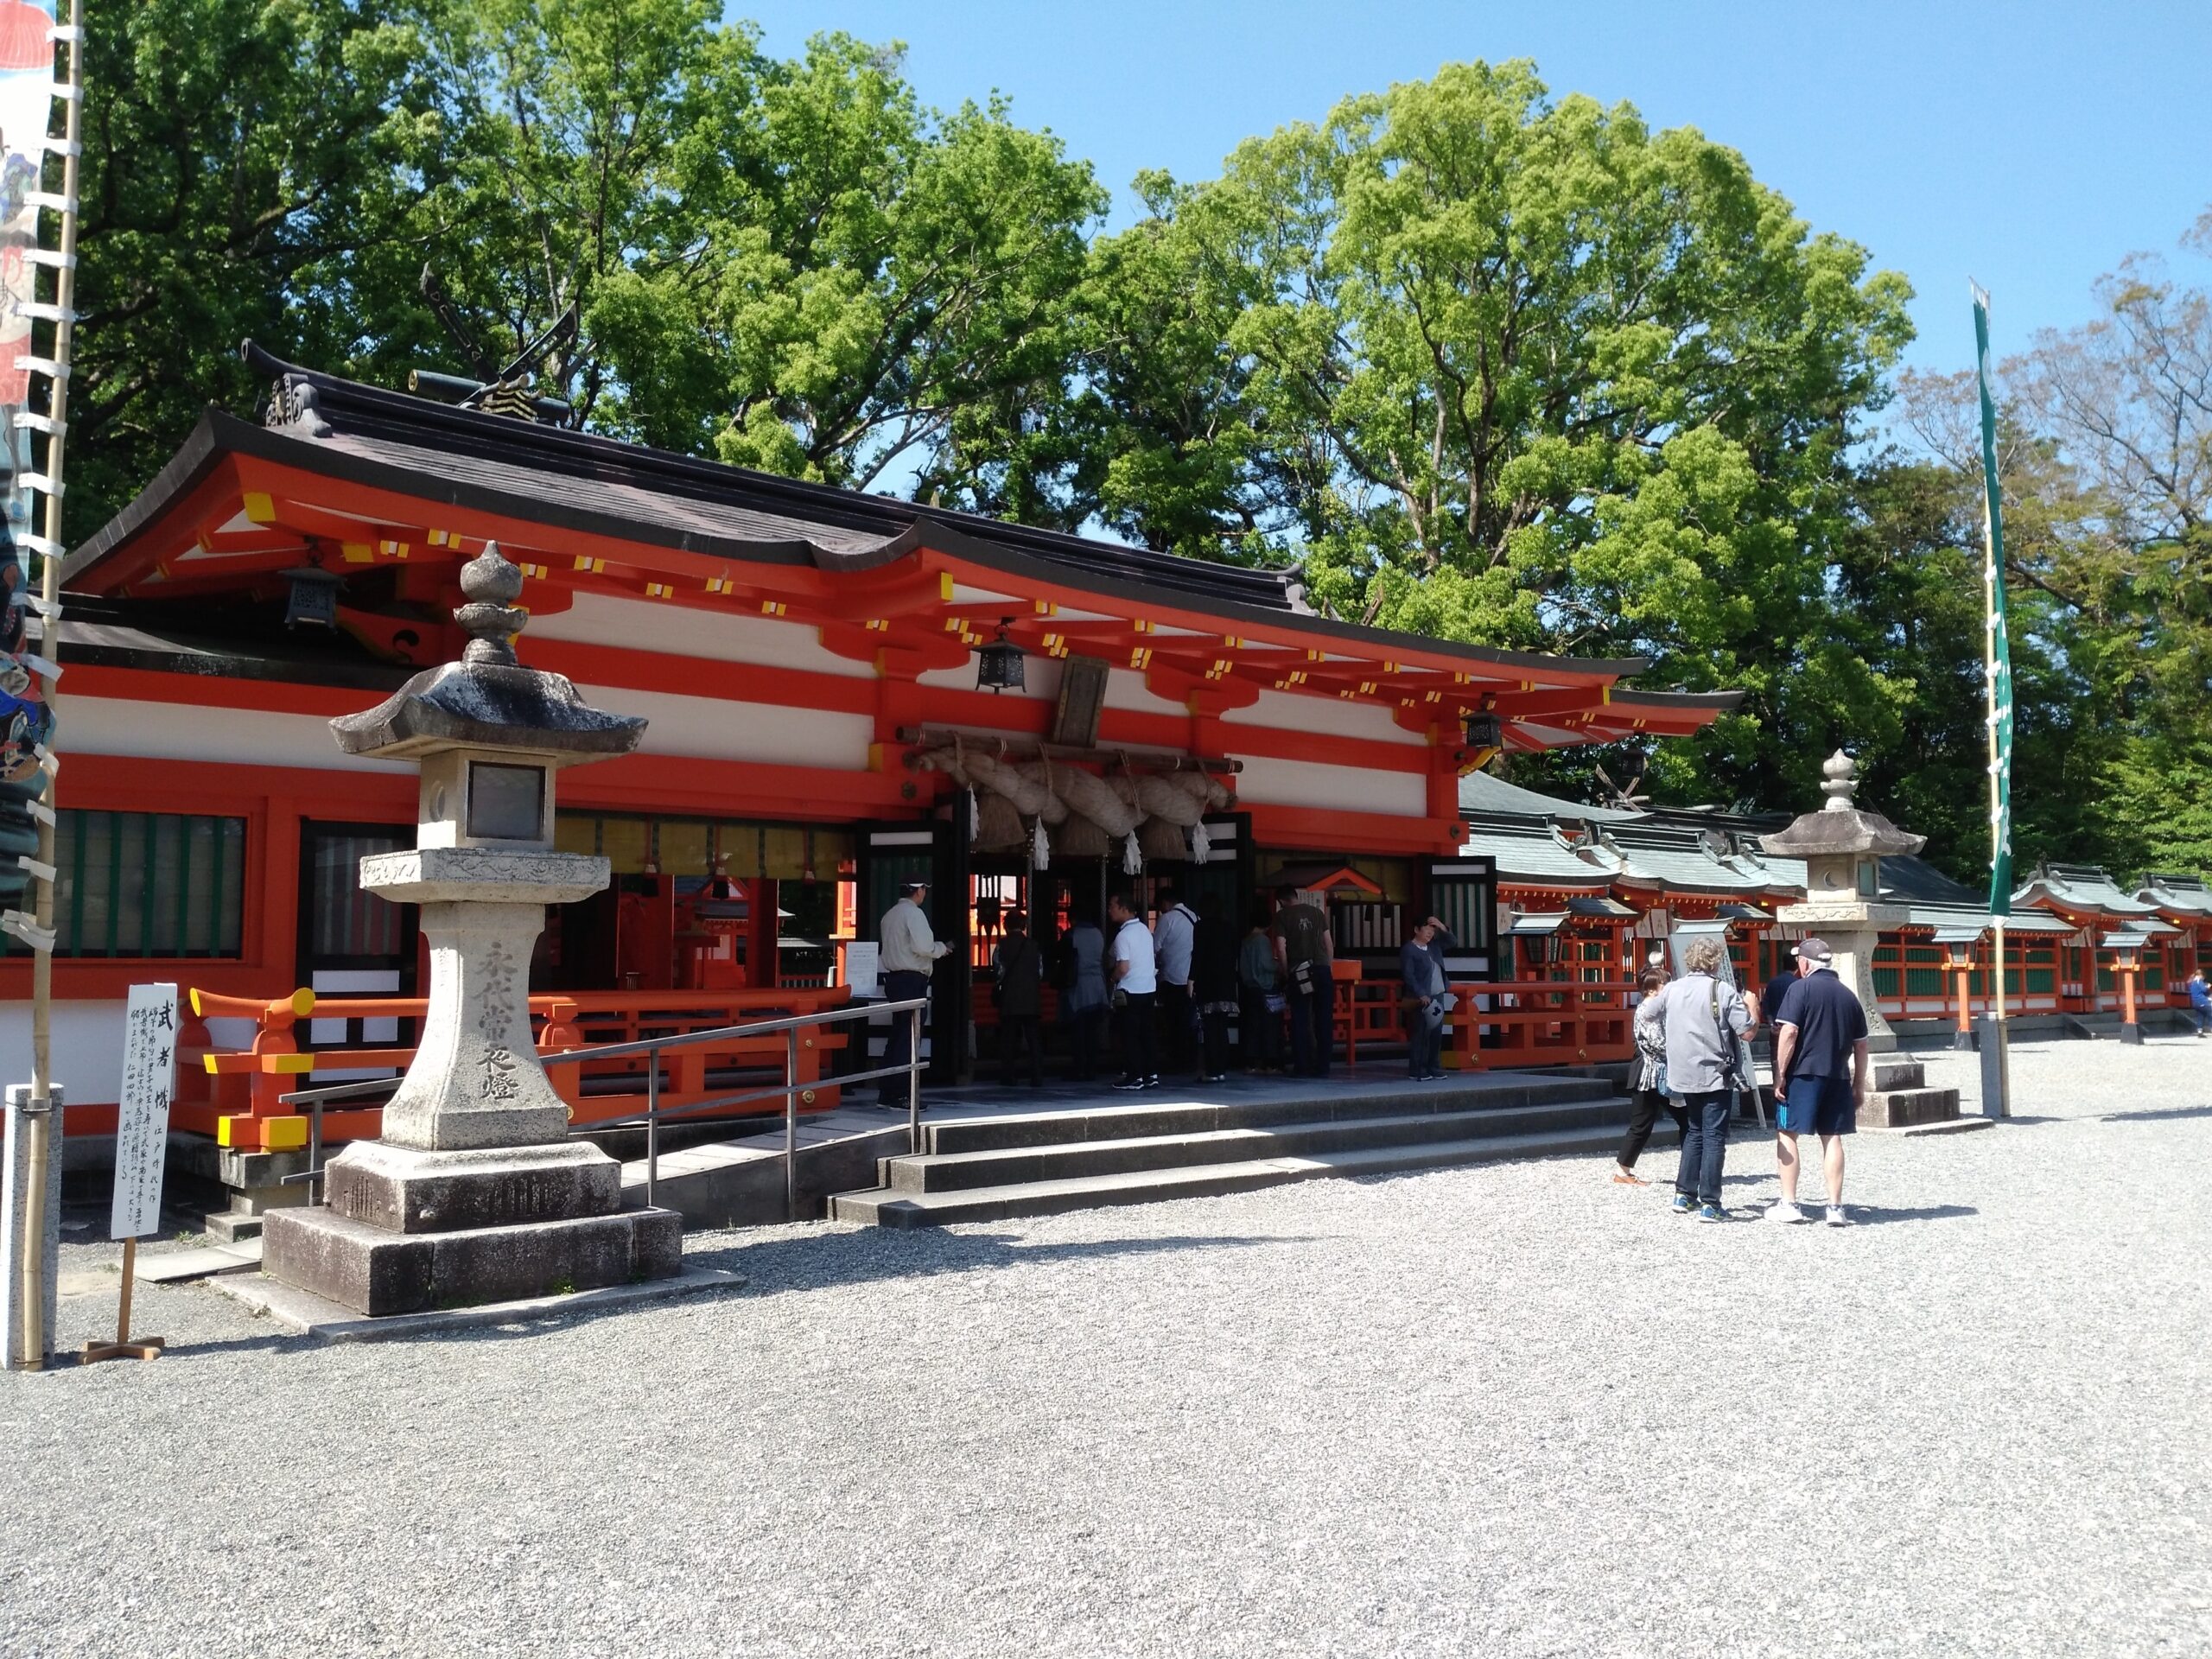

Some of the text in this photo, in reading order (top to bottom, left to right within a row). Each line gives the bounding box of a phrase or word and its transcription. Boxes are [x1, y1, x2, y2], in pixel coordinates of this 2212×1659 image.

[155, 1000, 174, 1111] 武者幟
[469, 942, 518, 1099] 永代常夜燈
